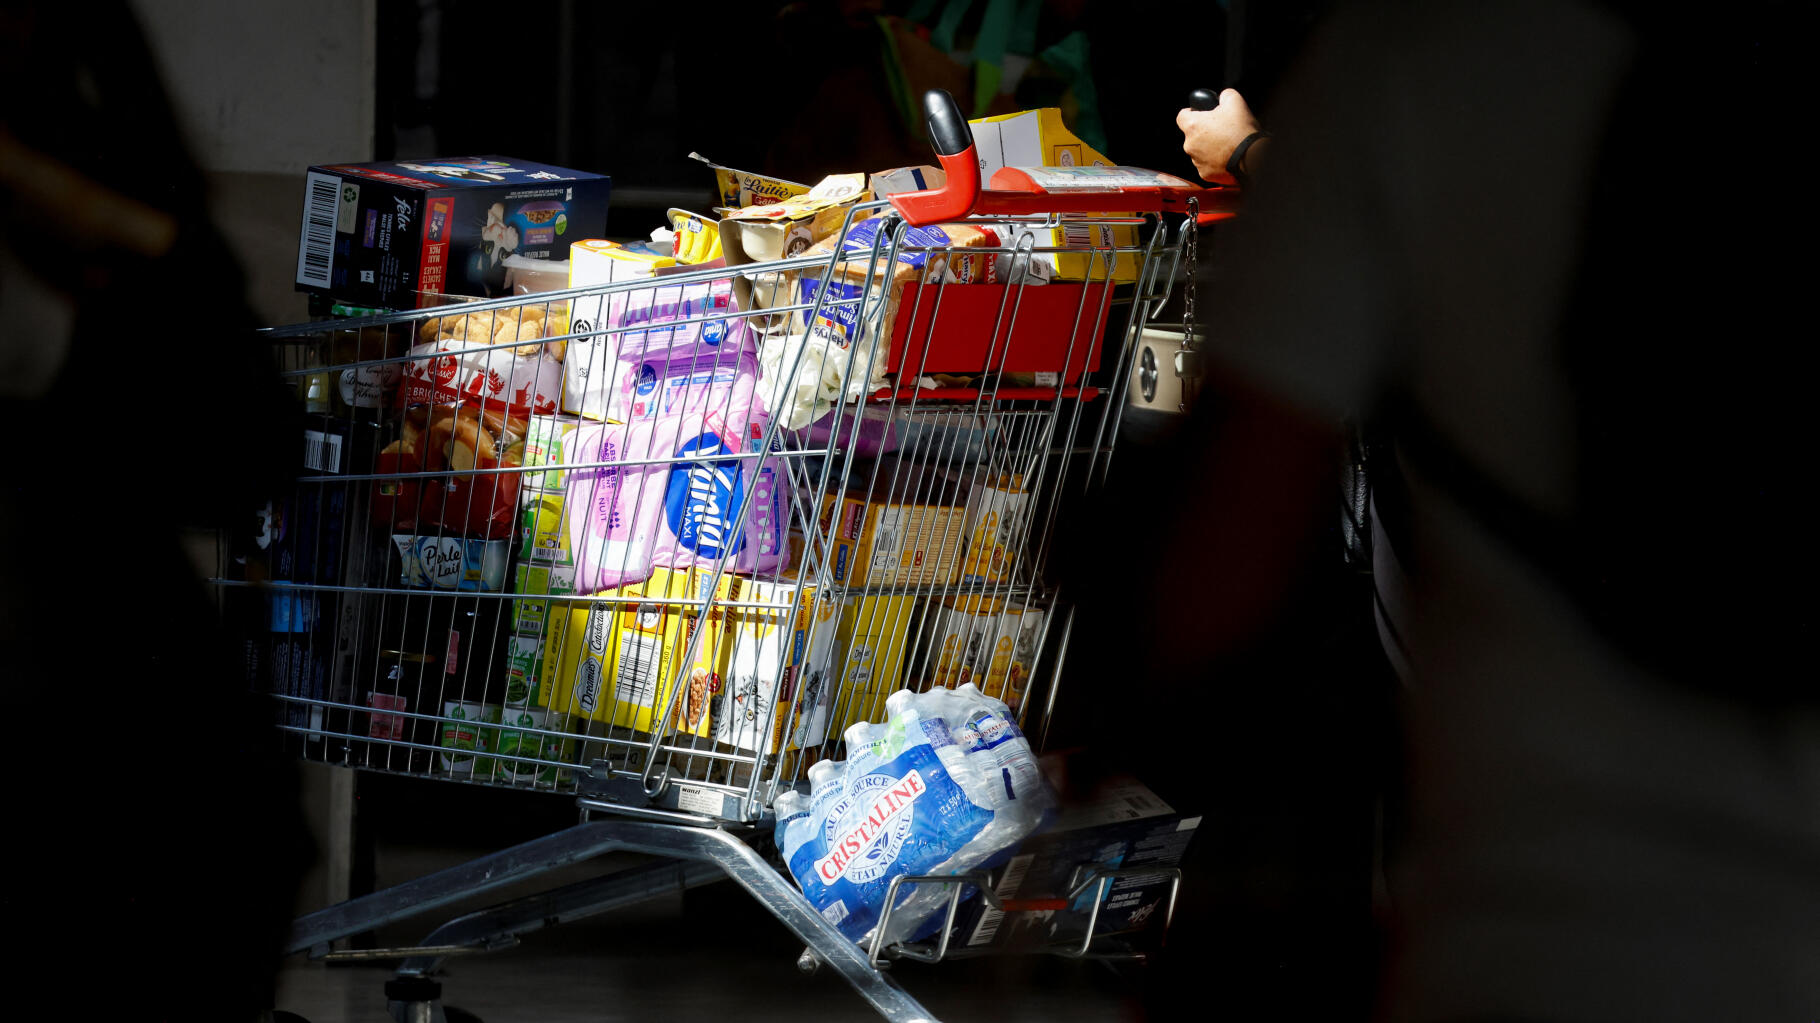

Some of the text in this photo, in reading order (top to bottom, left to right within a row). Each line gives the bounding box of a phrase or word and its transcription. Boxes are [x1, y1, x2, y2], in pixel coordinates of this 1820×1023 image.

[745, 178, 799, 199] Laitièr
[599, 497, 607, 522] NUIT
[684, 444, 732, 550] Vania
[684, 506, 692, 538] MAXI
[424, 545, 462, 565] Perle
[582, 663, 596, 706] Dreamies
[820, 773, 922, 880] CRISTALINE
[826, 814, 838, 842] EAU
